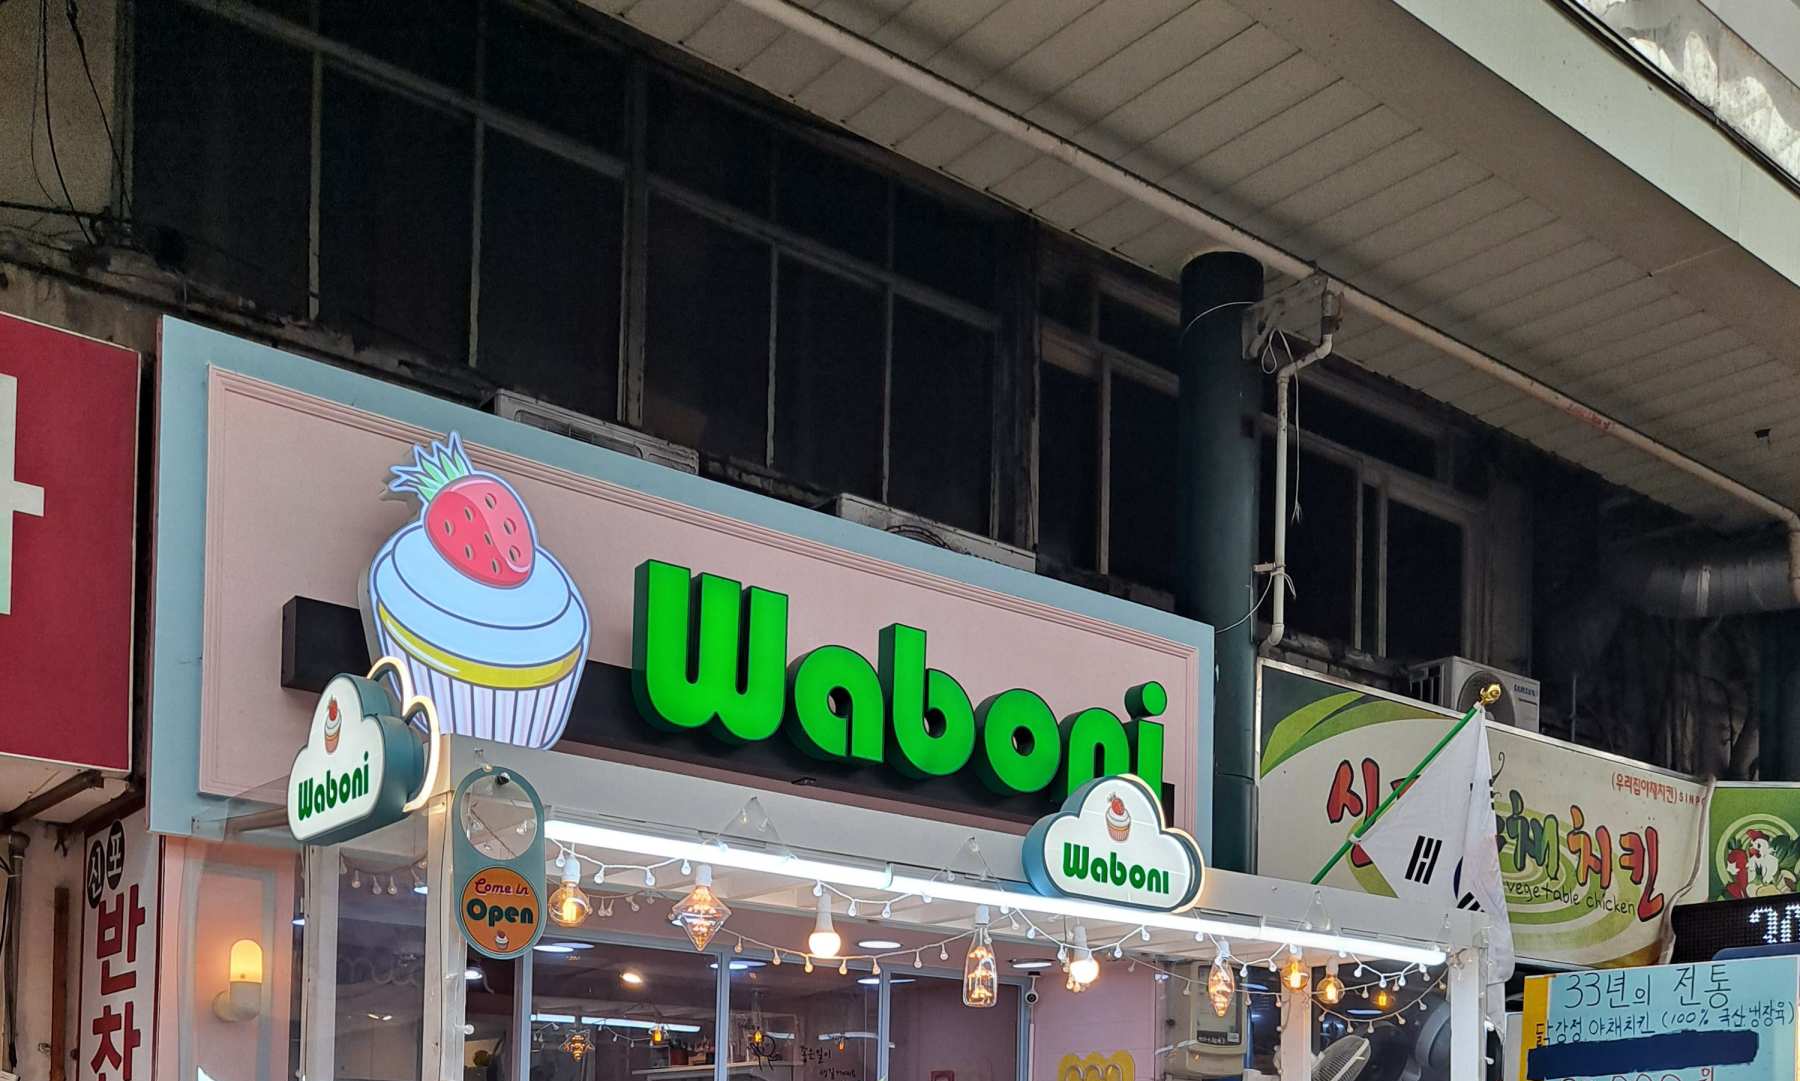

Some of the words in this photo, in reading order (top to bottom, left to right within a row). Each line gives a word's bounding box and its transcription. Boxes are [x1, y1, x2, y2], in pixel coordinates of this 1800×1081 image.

[634, 558, 1168, 802] Waboni
[298, 750, 369, 821] Waboni
[475, 878, 513, 895] Come
[516, 882, 530, 896] in
[1063, 842, 1170, 895] Waboni
[466, 898, 534, 927] Open
[1507, 880, 1580, 907] vegetable
[1586, 891, 1636, 917] chicken
[1564, 972, 1652, 1009] 33년의
[1673, 963, 1732, 1010] 전통
[1588, 1013, 1656, 1038] 야채치킨
[1661, 1008, 1709, 1028] (100%
